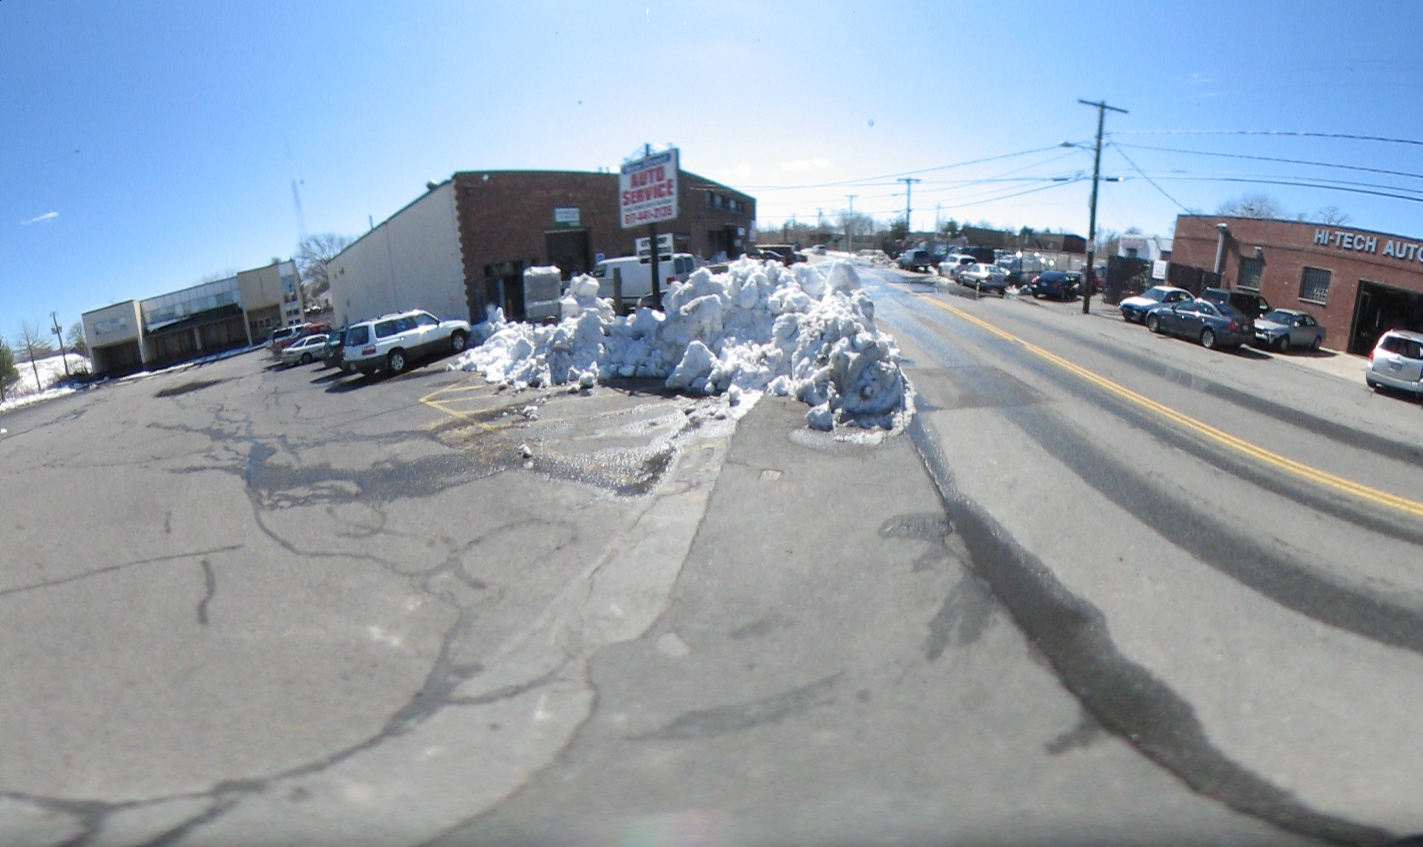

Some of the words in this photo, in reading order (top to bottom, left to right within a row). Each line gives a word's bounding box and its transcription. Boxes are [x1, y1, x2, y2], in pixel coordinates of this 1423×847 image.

[630, 166, 665, 189] AUTO
[622, 179, 673, 206] SERVICE
[1314, 229, 1377, 253] HI-TECH
